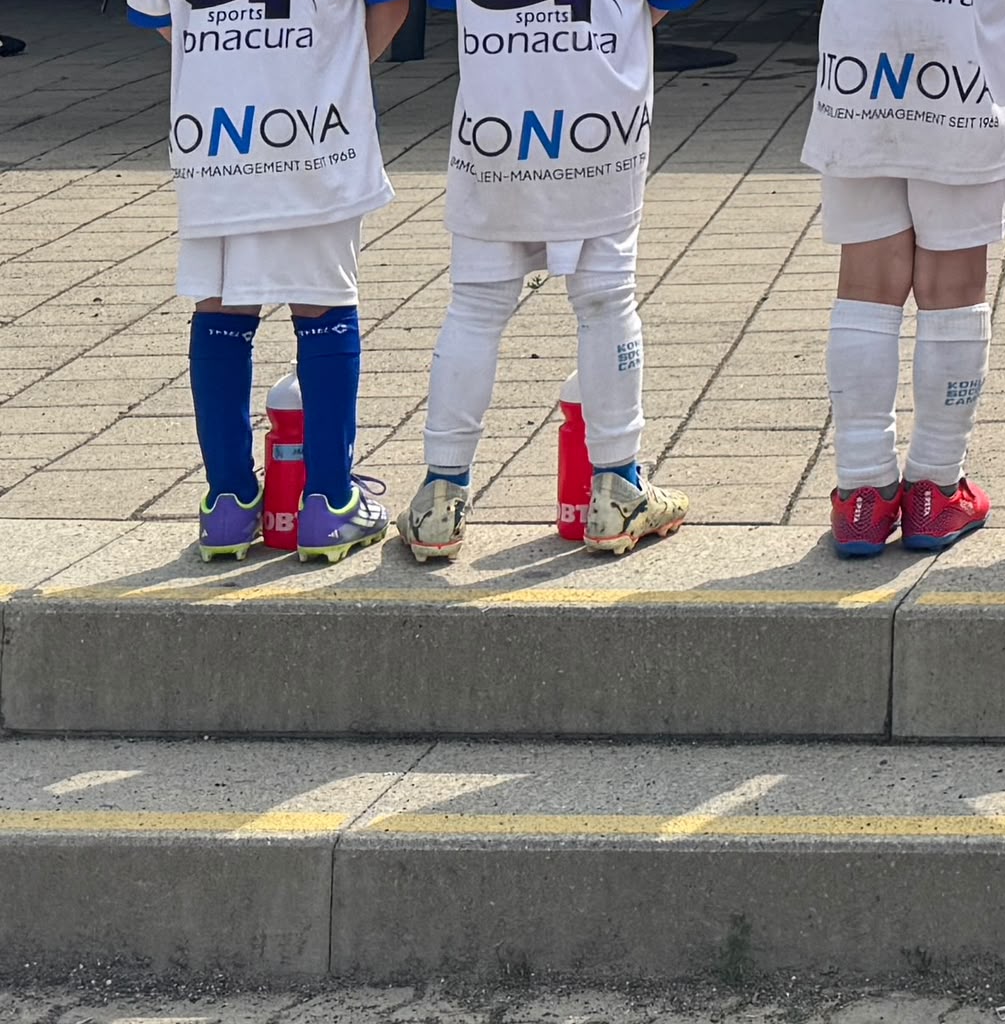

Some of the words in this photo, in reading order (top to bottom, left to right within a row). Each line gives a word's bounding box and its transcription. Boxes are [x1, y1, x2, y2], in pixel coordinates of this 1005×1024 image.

[208, 8, 263, 25] sports
[515, 10, 569, 26] sports
[949, 116, 977, 128] SEIT
[304, 156, 327, 171] SEIT
[329, 148, 357, 166] 1968
[615, 156, 638, 173] SEIT
